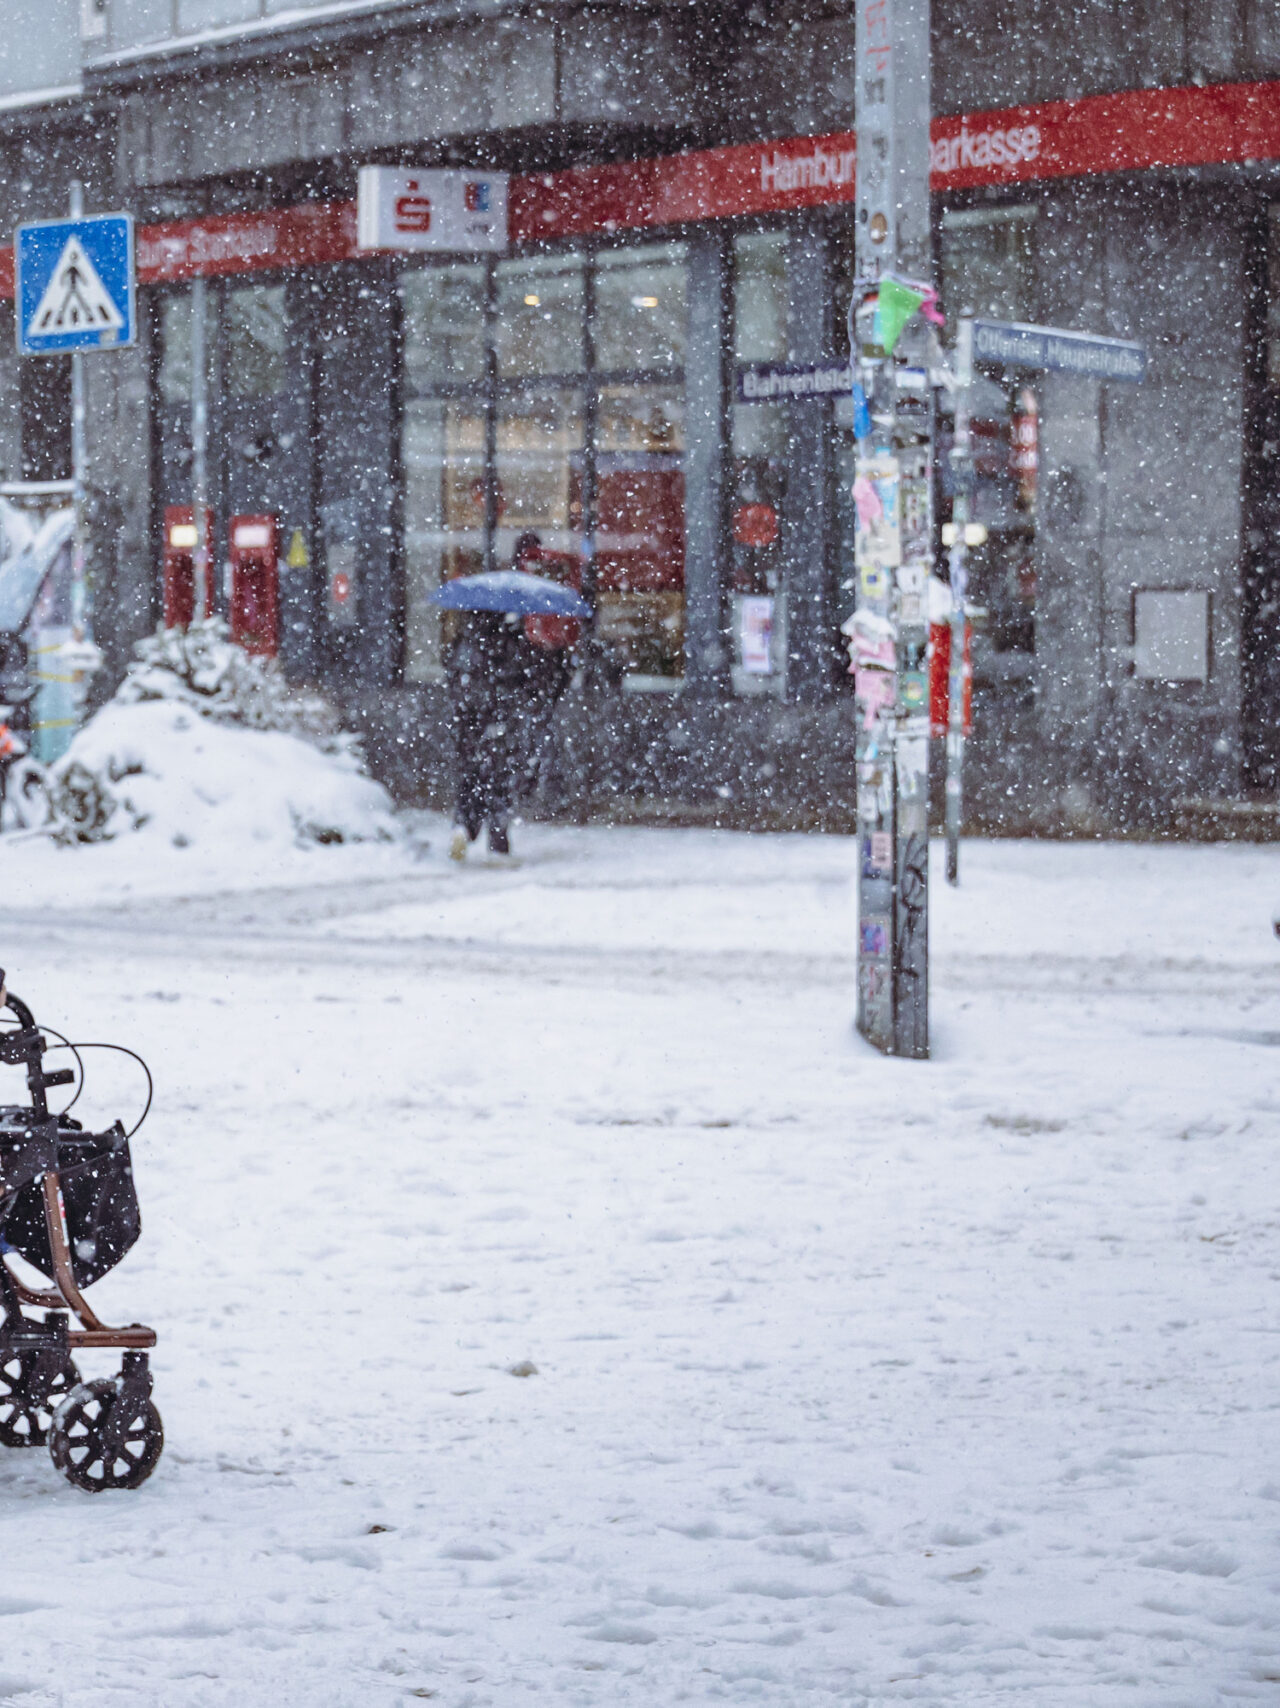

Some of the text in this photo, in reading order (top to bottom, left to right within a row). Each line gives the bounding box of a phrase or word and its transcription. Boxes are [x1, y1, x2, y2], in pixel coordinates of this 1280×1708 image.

[761, 124, 1042, 192] Hambur arkasse
[743, 366, 852, 397] Bahrenfeld
